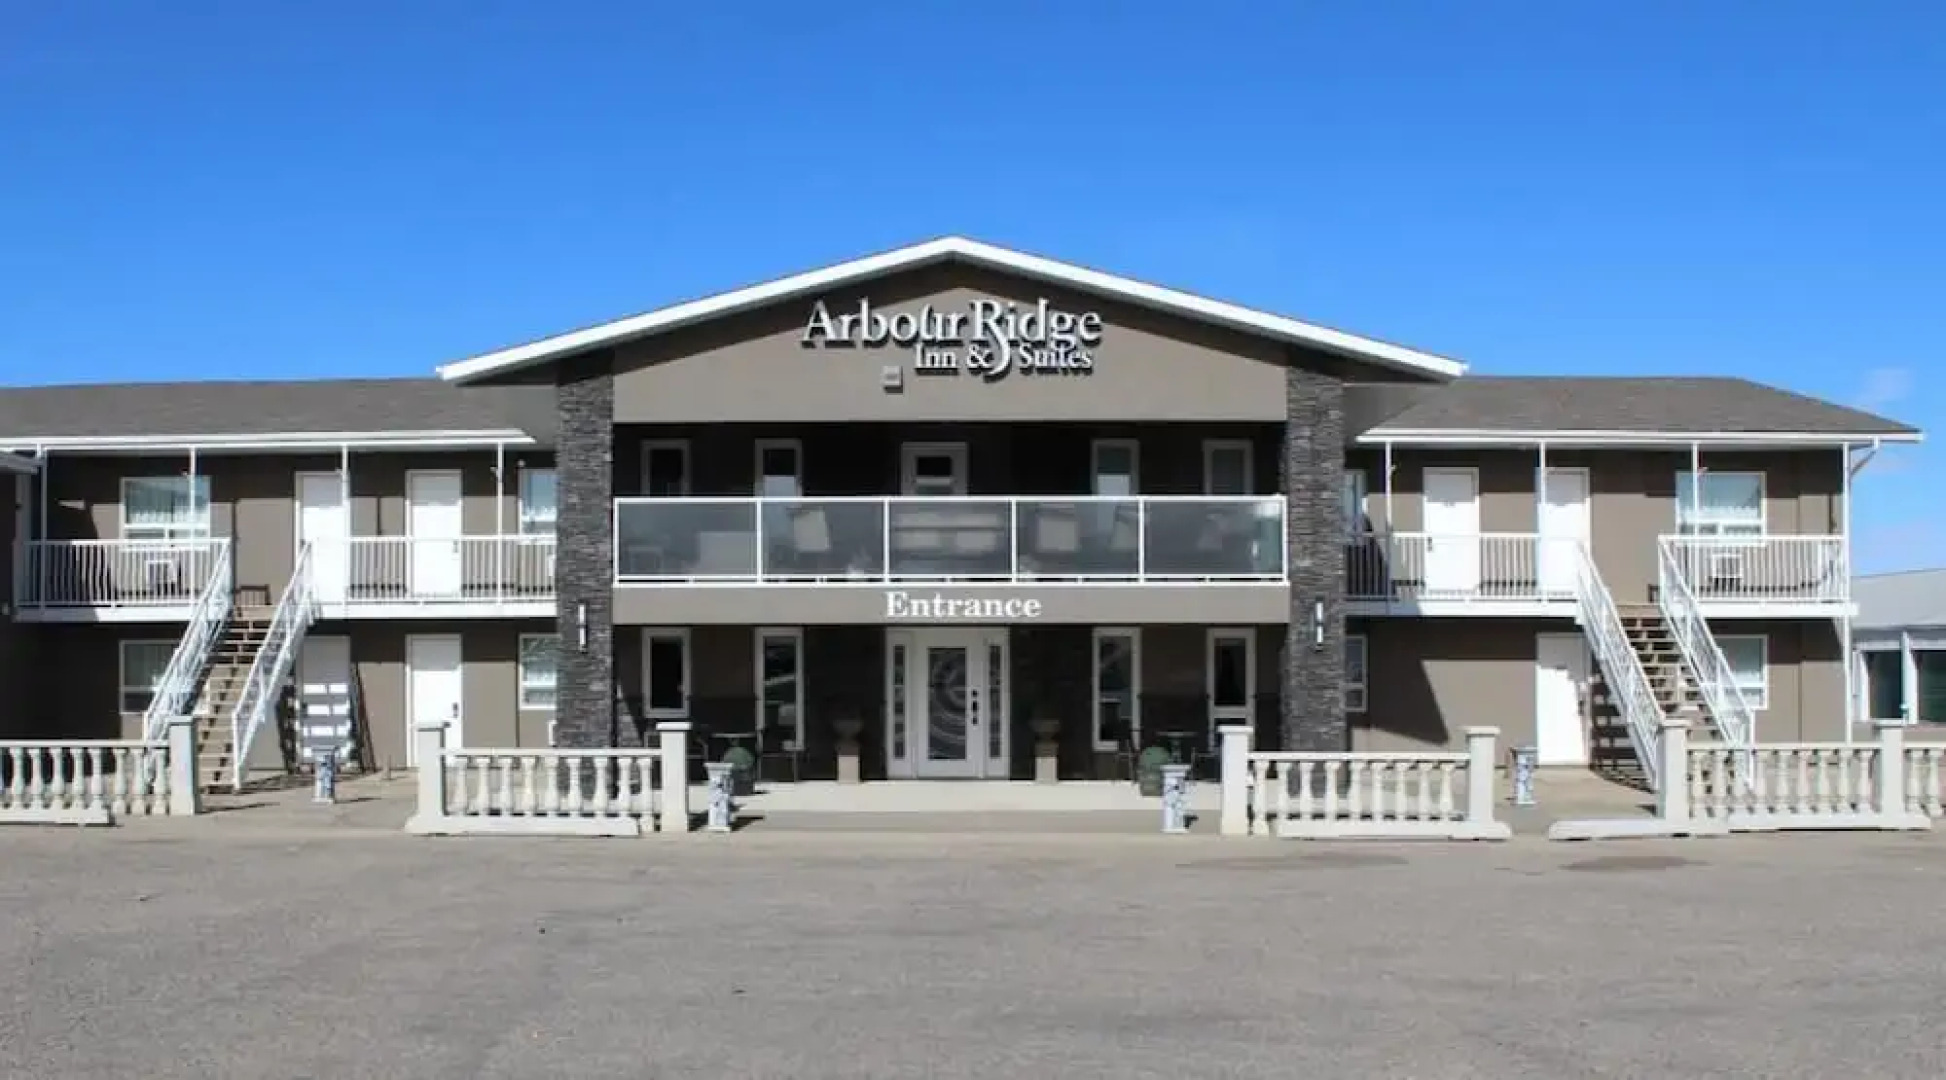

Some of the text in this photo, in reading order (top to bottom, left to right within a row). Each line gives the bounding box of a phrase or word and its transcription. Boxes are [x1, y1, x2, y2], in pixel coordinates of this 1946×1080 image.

[802, 297, 1102, 374] Arbour Ridge
[915, 343, 1092, 369] Inn & Suites
[885, 591, 1042, 618] Entrance
